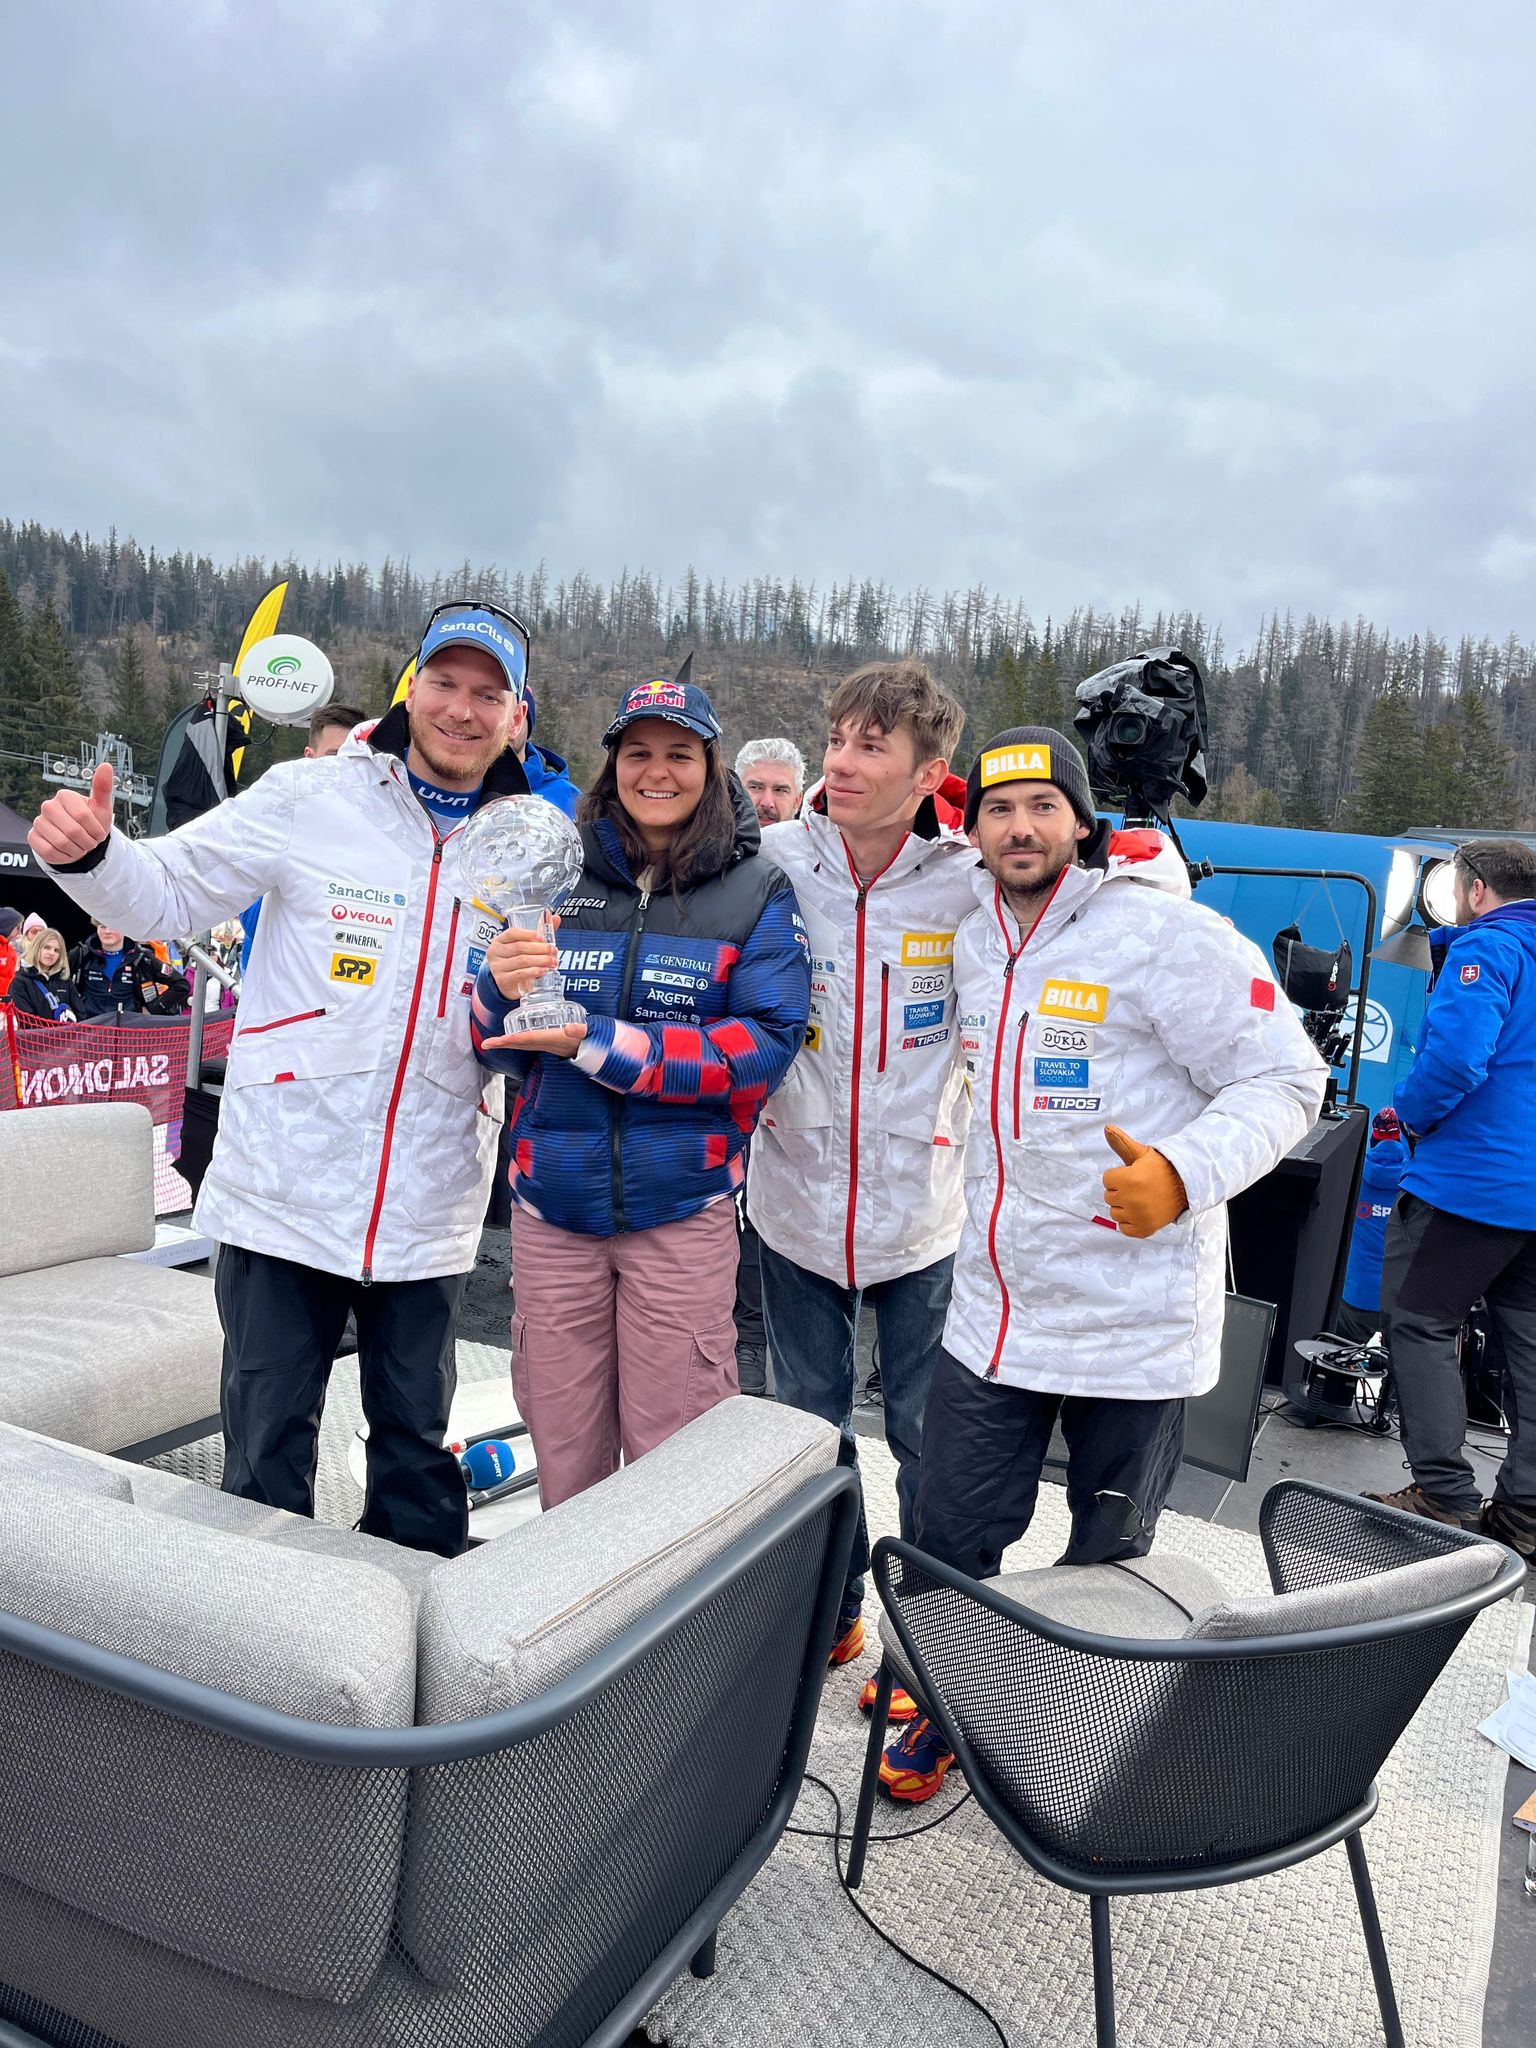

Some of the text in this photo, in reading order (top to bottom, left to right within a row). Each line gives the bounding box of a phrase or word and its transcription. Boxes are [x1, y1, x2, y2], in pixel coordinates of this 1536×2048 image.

[439, 622, 503, 645] SanaClis
[247, 675, 318, 694] PROFI-NET
[626, 693, 685, 713] Red Bull
[986, 752, 1045, 777] BILLA
[328, 883, 391, 903] SanaClis
[560, 898, 607, 909] NERGIA
[350, 910, 393, 926] VEOLIA
[555, 907, 580, 916] URA
[346, 933, 378, 950] MINERFIN
[334, 958, 371, 980] SPP
[660, 955, 712, 973] GENERALI
[566, 978, 601, 992] HPB
[653, 972, 694, 986] SPAR
[912, 980, 945, 990] DUKLA
[647, 988, 695, 1006] ARGETA
[1044, 987, 1099, 1013] BILLA
[635, 1007, 688, 1021] SanaClis
[909, 1006, 930, 1014] TRAVEL
[918, 1031, 948, 1046] TIPOS
[1044, 1033, 1087, 1046] DUKLA
[1040, 1061, 1080, 1070] TRAVEL TO
[1040, 1068, 1075, 1077] SLOVAKIA
[1040, 1075, 1083, 1084] GOOD IDEA
[1051, 1098, 1098, 1110] TIPOS
